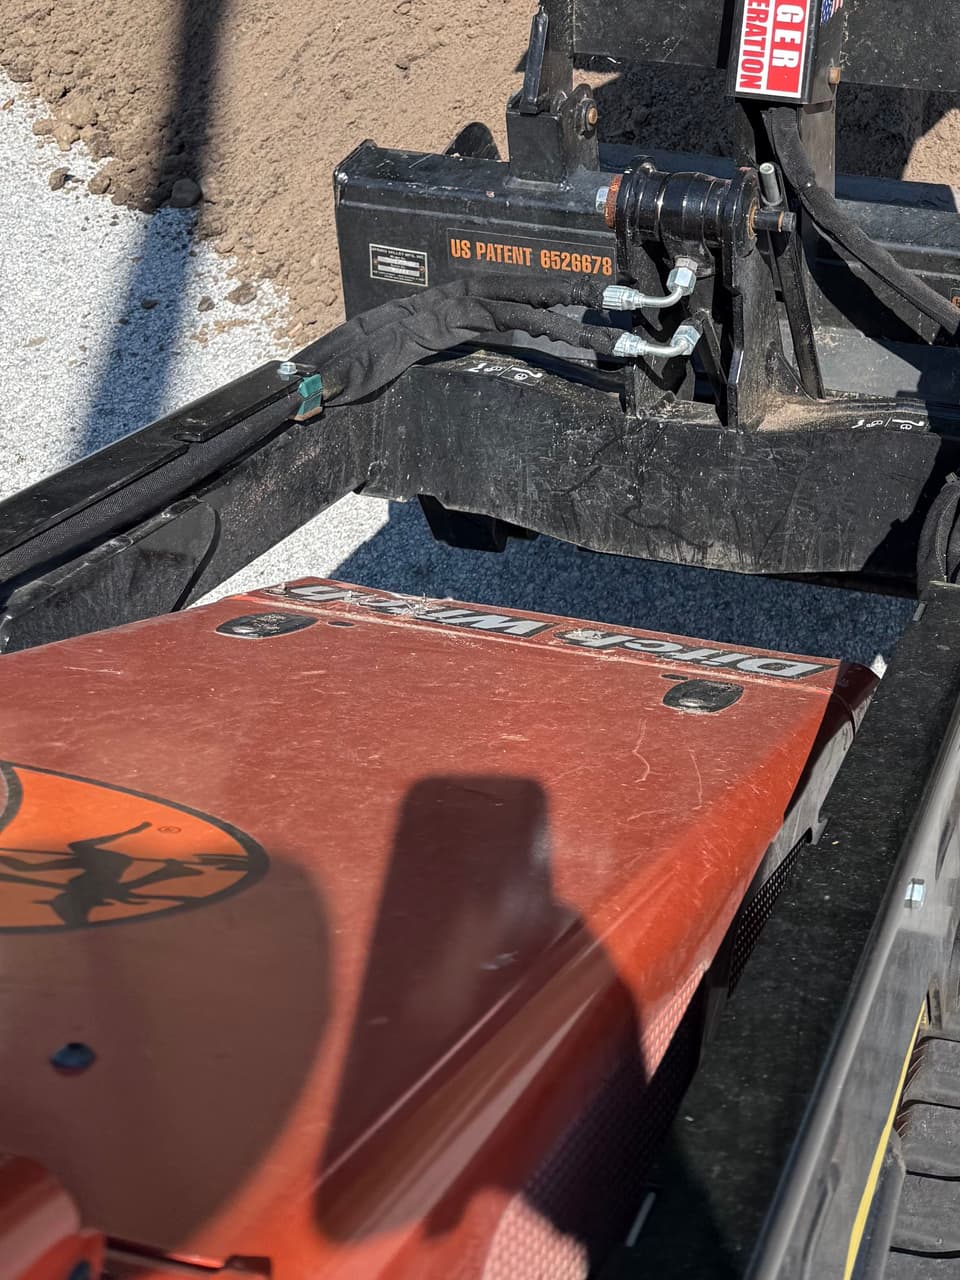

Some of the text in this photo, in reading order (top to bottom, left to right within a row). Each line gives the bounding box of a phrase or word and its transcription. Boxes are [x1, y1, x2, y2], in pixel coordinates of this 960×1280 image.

[450, 239, 612, 276] US PATENT 6526678
[562, 630, 825, 677] Ditch
